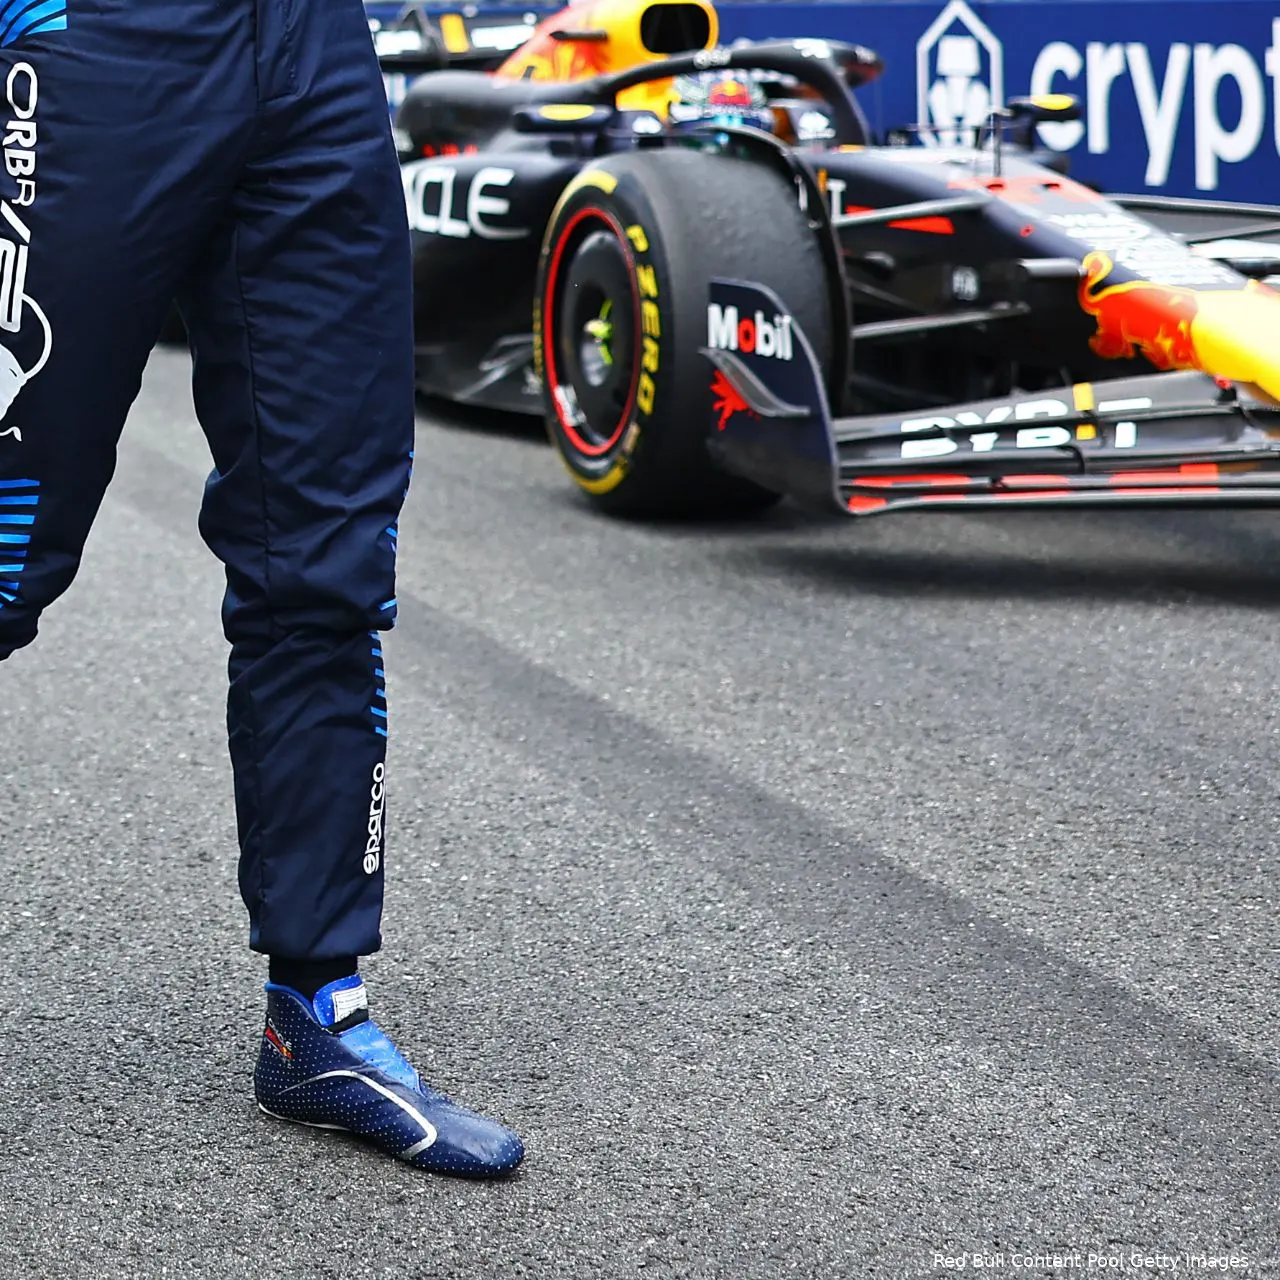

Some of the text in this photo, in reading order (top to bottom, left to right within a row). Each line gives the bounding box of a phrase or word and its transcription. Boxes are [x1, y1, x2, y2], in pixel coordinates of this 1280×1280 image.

[1030, 38, 1280, 191] cryp
[401, 166, 530, 240] CLE
[706, 303, 794, 362] Mobil
[362, 761, 386, 875] sparco
